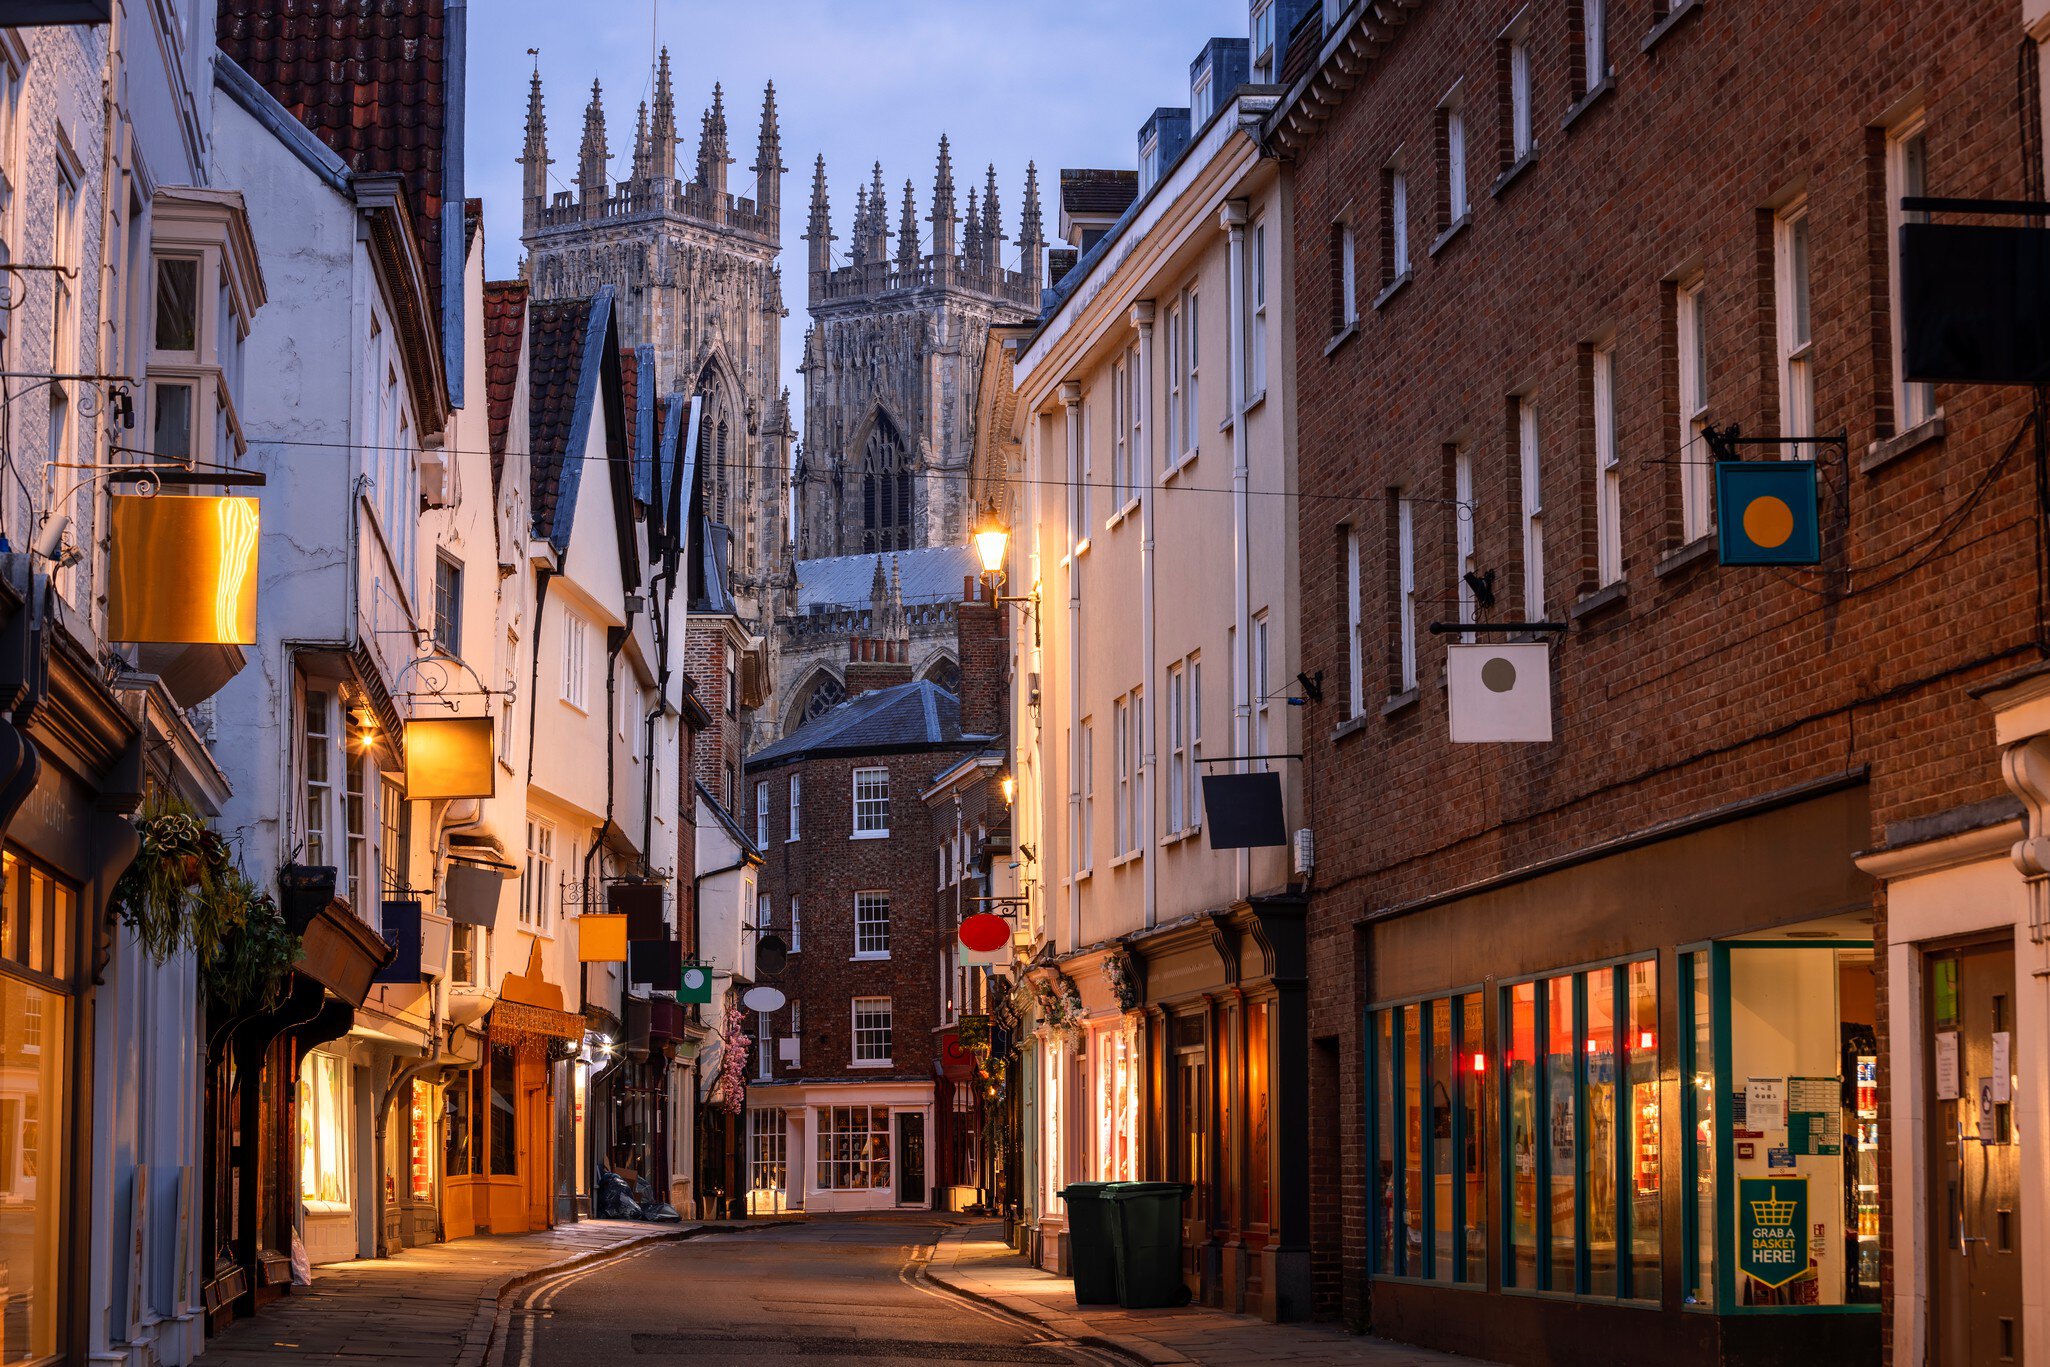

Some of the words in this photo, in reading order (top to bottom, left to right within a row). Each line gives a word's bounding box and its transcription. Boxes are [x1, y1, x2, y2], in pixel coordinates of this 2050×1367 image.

[1752, 1228, 1784, 1238] GRAB
[1786, 1228, 1796, 1238] A
[1752, 1239, 1796, 1249] BASKET
[1752, 1249, 1796, 1263] HERE!
